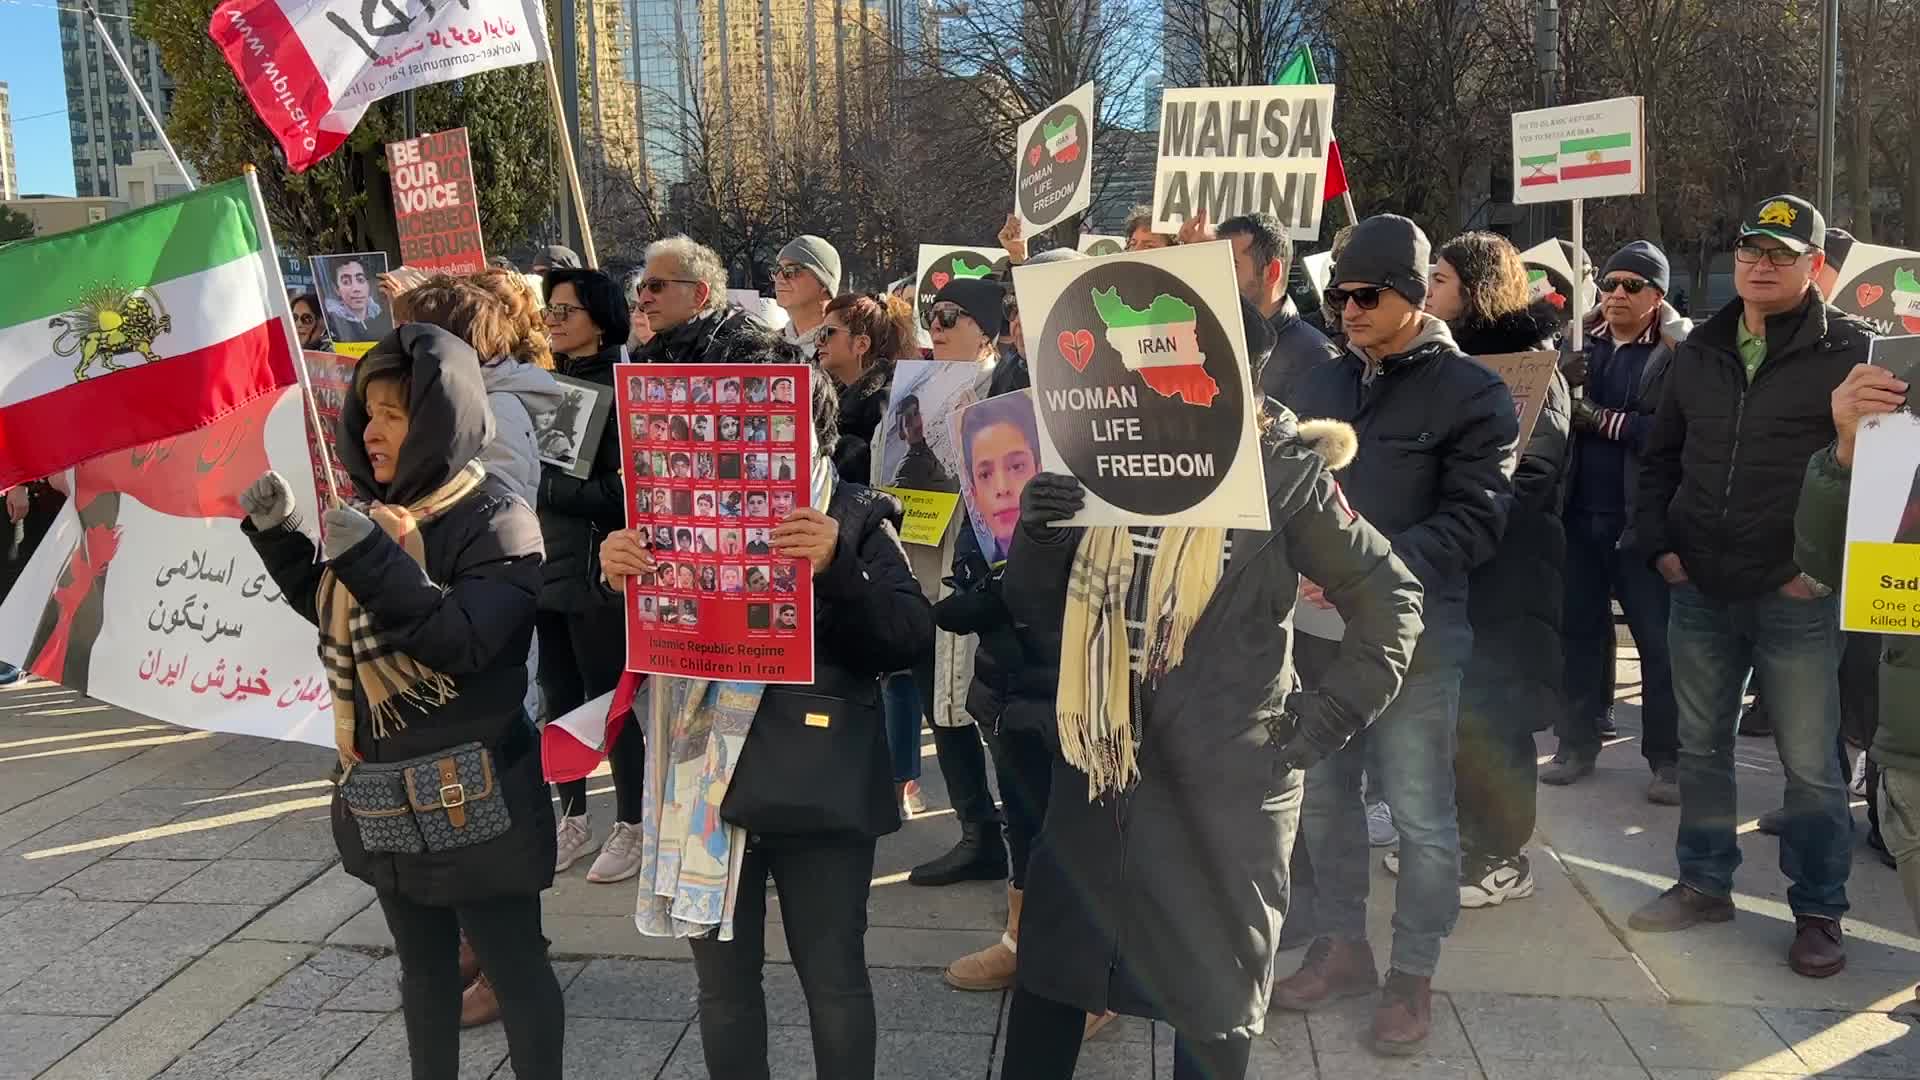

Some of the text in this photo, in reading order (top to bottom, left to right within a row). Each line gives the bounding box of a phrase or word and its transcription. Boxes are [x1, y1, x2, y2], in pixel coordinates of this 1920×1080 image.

[1162, 98, 1323, 159] MAHSA
[392, 140, 421, 166] BE
[395, 161, 439, 190] OUR
[1020, 163, 1053, 191] WOMAN
[1034, 178, 1053, 198] LIFE
[399, 182, 460, 213] VOICE
[1033, 181, 1075, 214] FREEDOM
[1159, 171, 1317, 229] AMINI
[1138, 336, 1177, 354] IRAN
[1045, 385, 1138, 412] WOMAN
[1091, 418, 1143, 442] LIFE
[1096, 453, 1215, 477] FREEDOM
[156, 549, 235, 587] اسلامی
[148, 593, 244, 643] سرنگون
[1872, 599, 1906, 611] One
[687, 640, 736, 656] Republic
[738, 643, 785, 659] Regime
[139, 648, 189, 686] ایران
[191, 657, 272, 701] خیزش
[679, 657, 734, 674] Children
[757, 663, 785, 676] Iran
